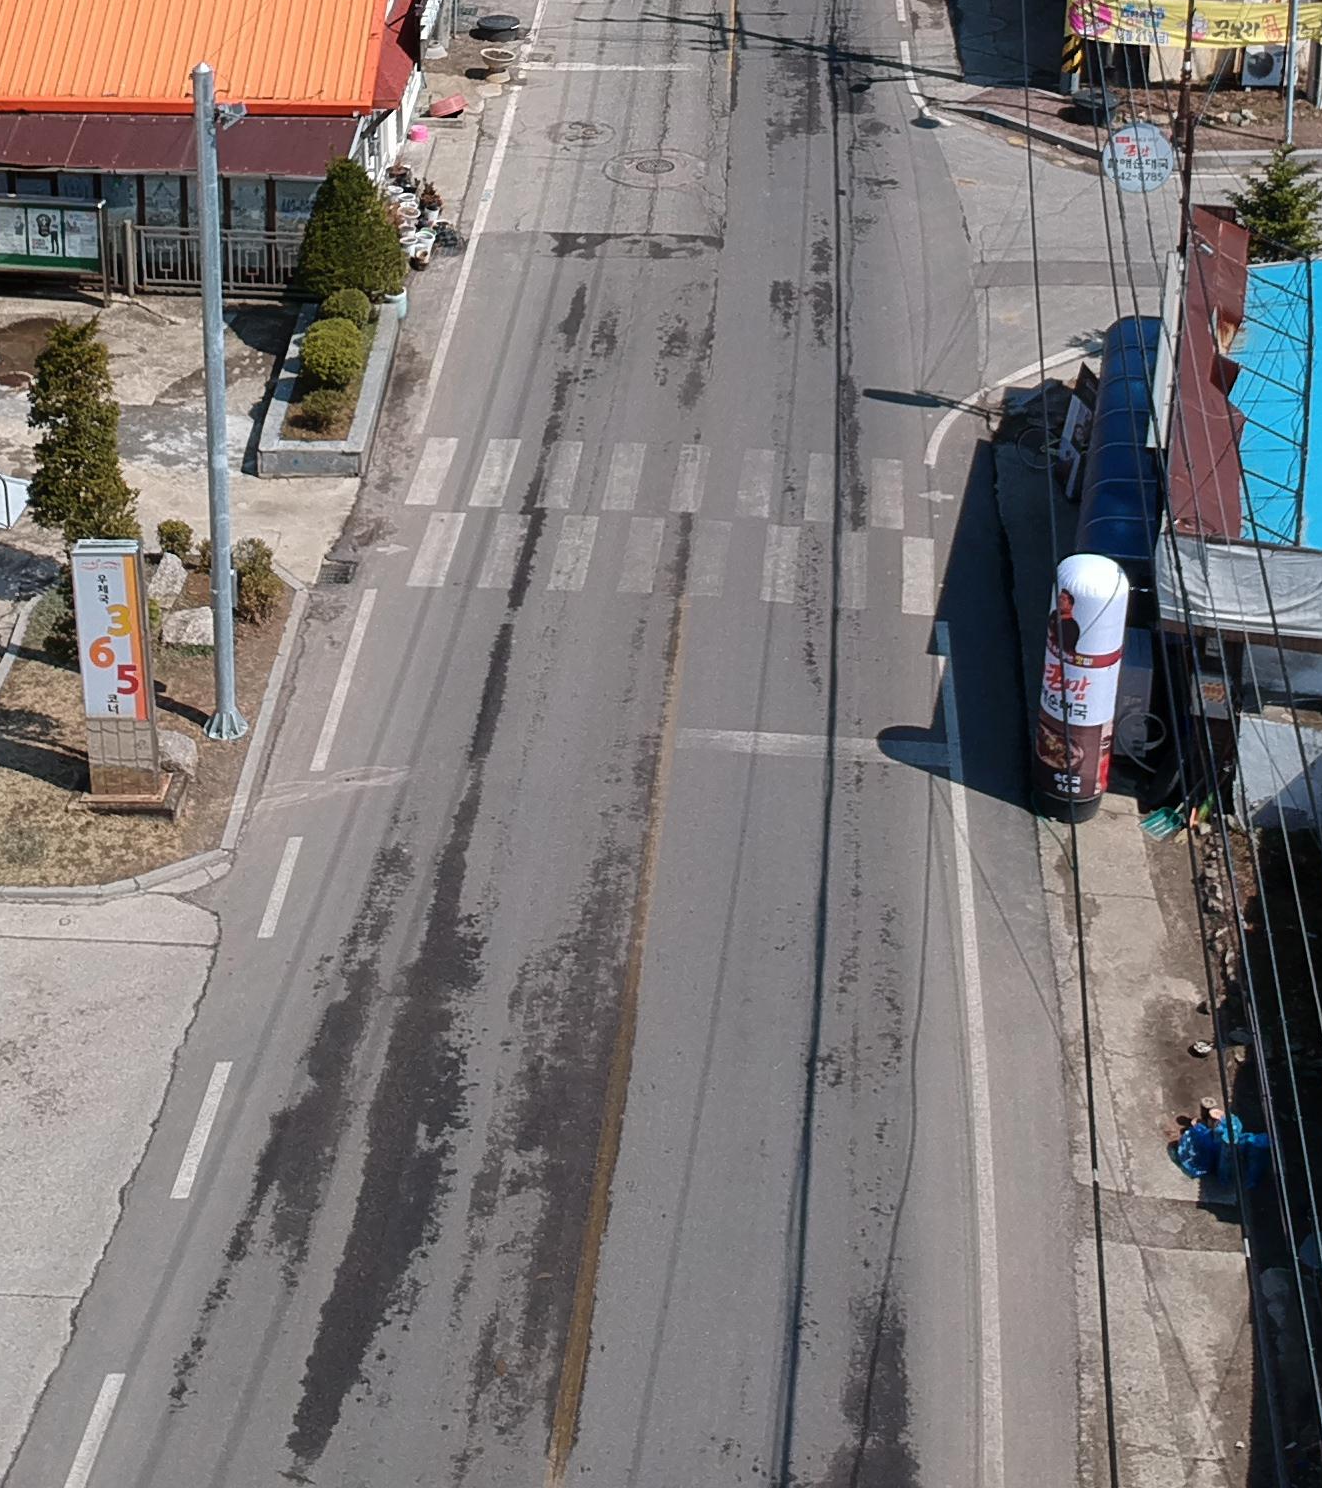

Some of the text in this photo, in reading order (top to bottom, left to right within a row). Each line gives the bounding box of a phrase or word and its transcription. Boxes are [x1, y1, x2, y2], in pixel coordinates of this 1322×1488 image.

[97, 574, 109, 605] 우체국
[89, 603, 140, 695] 365
[107, 694, 120, 715] 코너
